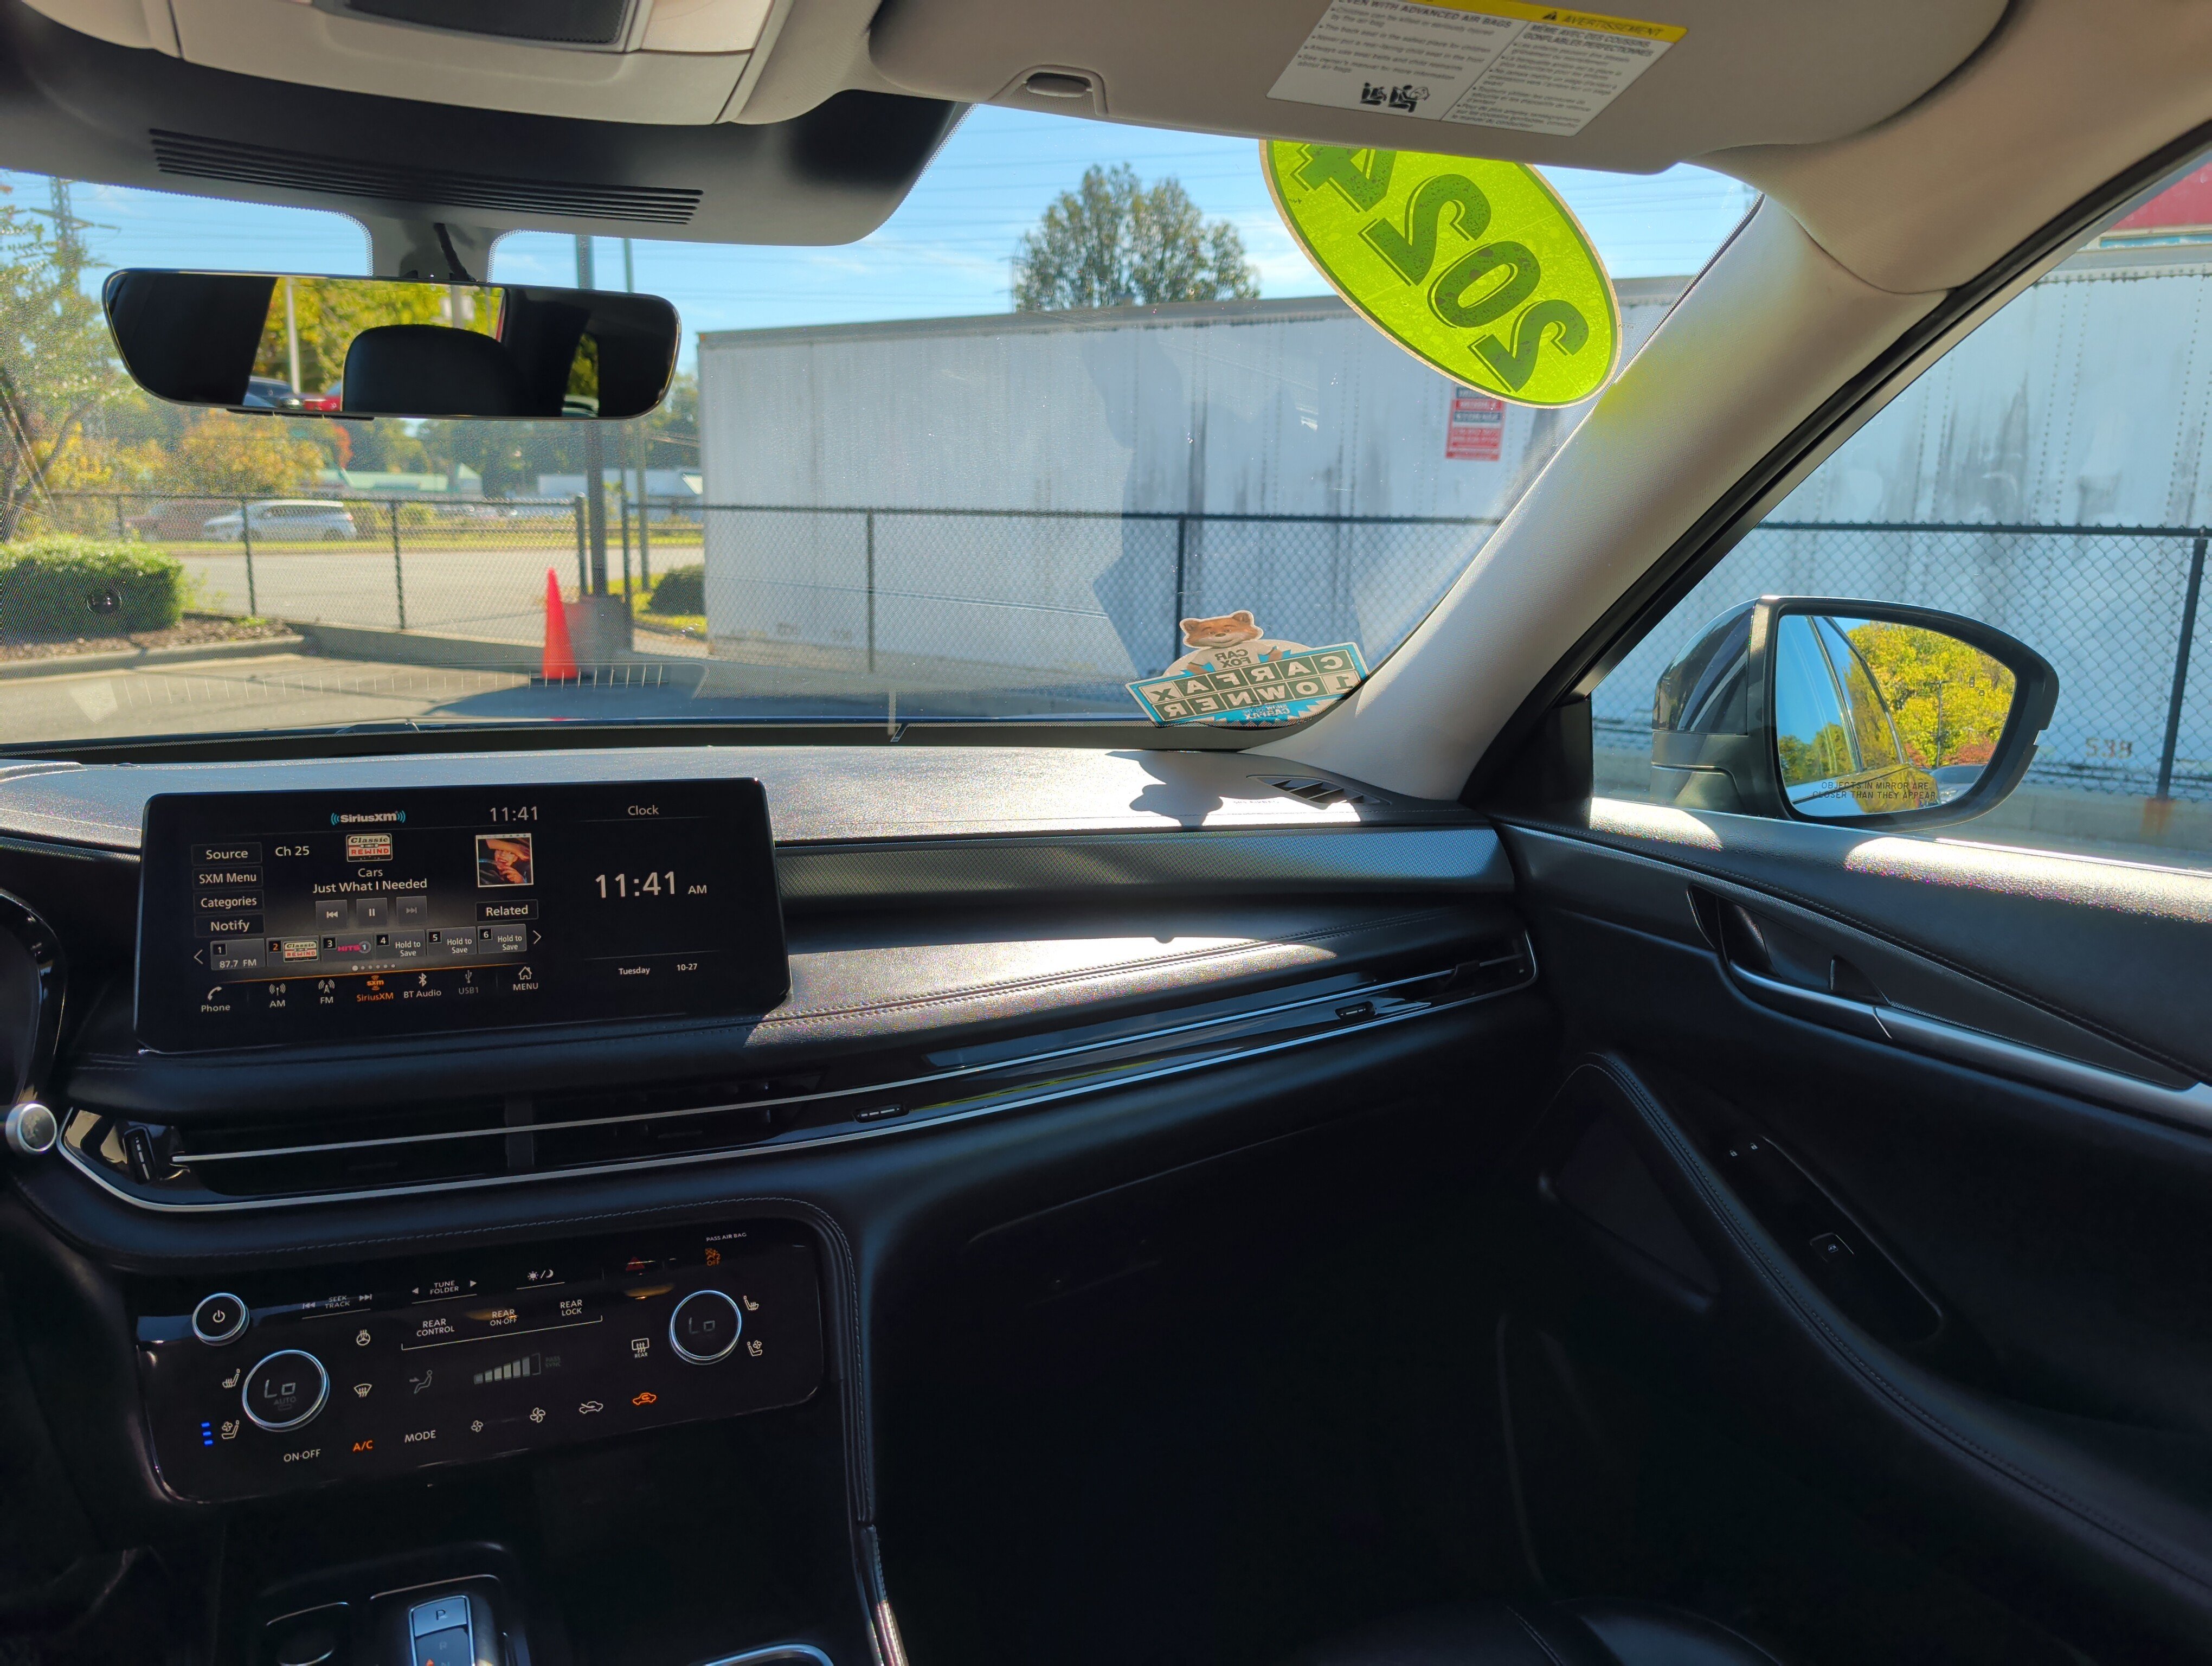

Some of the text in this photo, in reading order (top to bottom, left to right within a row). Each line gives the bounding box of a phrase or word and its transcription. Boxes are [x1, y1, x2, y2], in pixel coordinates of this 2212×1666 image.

[1371, 1, 1400, 11] WITH
[1400, 5, 1460, 20] ADVANCED
[1462, 15, 1481, 23] AIR
[1482, 18, 1512, 28] BAGS
[1821, 781, 1862, 790] OBJECTS
[1902, 791, 1937, 799] APPEAR
[490, 805, 539, 822] 11:41
[628, 804, 659, 816] Clock
[206, 849, 248, 860] Source
[275, 845, 310, 857] Ch 25
[358, 868, 383, 877] Cars
[199, 873, 256, 884] SXM Menu
[313, 878, 427, 894] Just What I Needed
[595, 871, 708, 899] 11:41 AM
[200, 897, 258, 909] Categories
[486, 905, 528, 917] Related
[210, 920, 250, 933] Notify
[395, 940, 412, 949] Hold
[447, 938, 463, 946] Hold
[400, 950, 417, 958] Save
[220, 959, 257, 969] 87.7 FM
[676, 963, 698, 972] 10-27
[618, 966, 651, 976] Tuesday
[458, 986, 479, 995] USB1
[513, 982, 539, 991] MENU
[356, 992, 394, 1003] SiriusXM
[403, 989, 442, 999] BT Audio
[269, 999, 286, 1008] AM
[320, 996, 334, 1004] FM
[201, 1003, 231, 1013] Phone
[434, 1280, 455, 1289] TUNE
[429, 1286, 460, 1295] FOLDER
[328, 1295, 348, 1303] SEEK
[560, 1299, 583, 1309] REAR
[324, 1300, 351, 1310] TRACK
[491, 1309, 515, 1319] REAR
[561, 1307, 583, 1317] LOCK
[422, 1318, 447, 1329] REAR
[416, 1325, 455, 1338] CONTROL
[273, 1396, 297, 1406] AUTO
[404, 1430, 437, 1444] MODE
[353, 1440, 373, 1453] A/C
[435, 1609, 447, 1621] P
